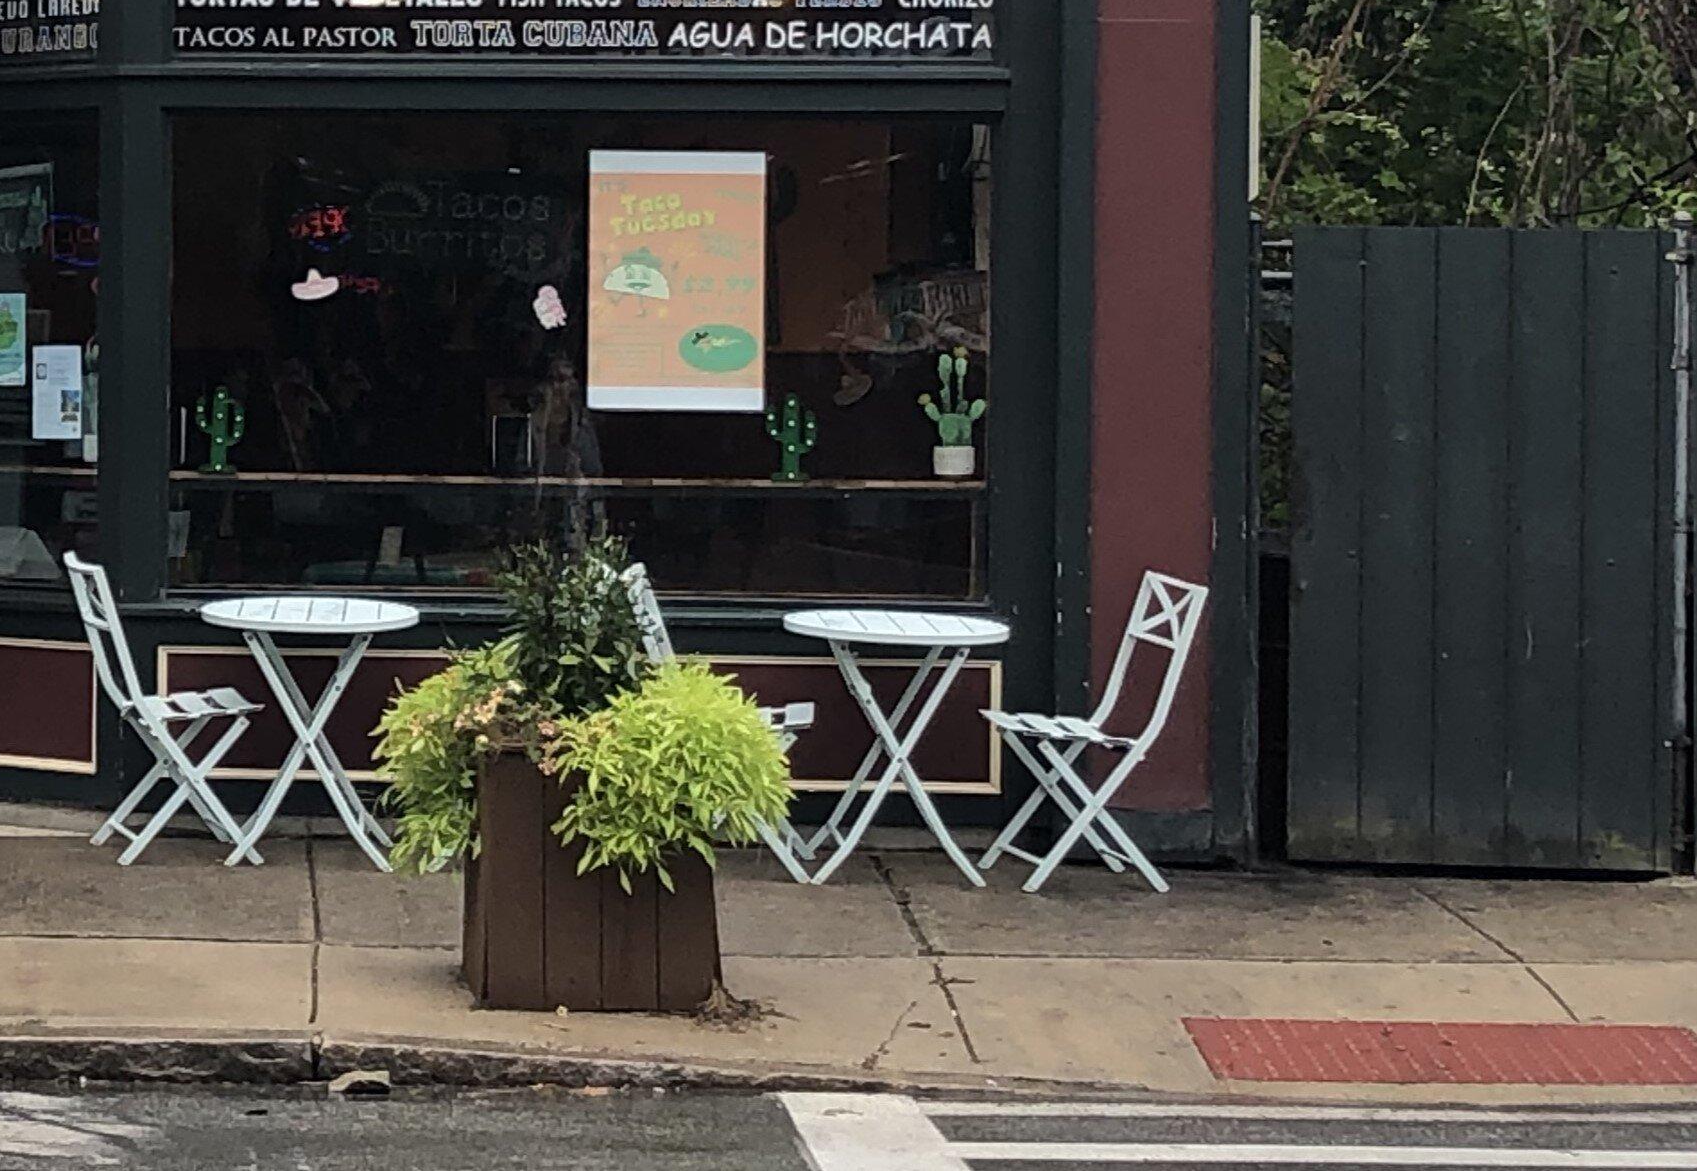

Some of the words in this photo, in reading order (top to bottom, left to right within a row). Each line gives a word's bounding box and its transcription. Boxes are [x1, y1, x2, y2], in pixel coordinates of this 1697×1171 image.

[172, 26, 255, 47] TACOS
[262, 27, 294, 47] AL
[303, 26, 397, 47] PASTOR
[410, 20, 515, 47] TORTA
[522, 20, 658, 47] CUBANA
[667, 22, 754, 48] AGUA
[765, 22, 806, 48] DE
[815, 22, 992, 48] HORCHATA
